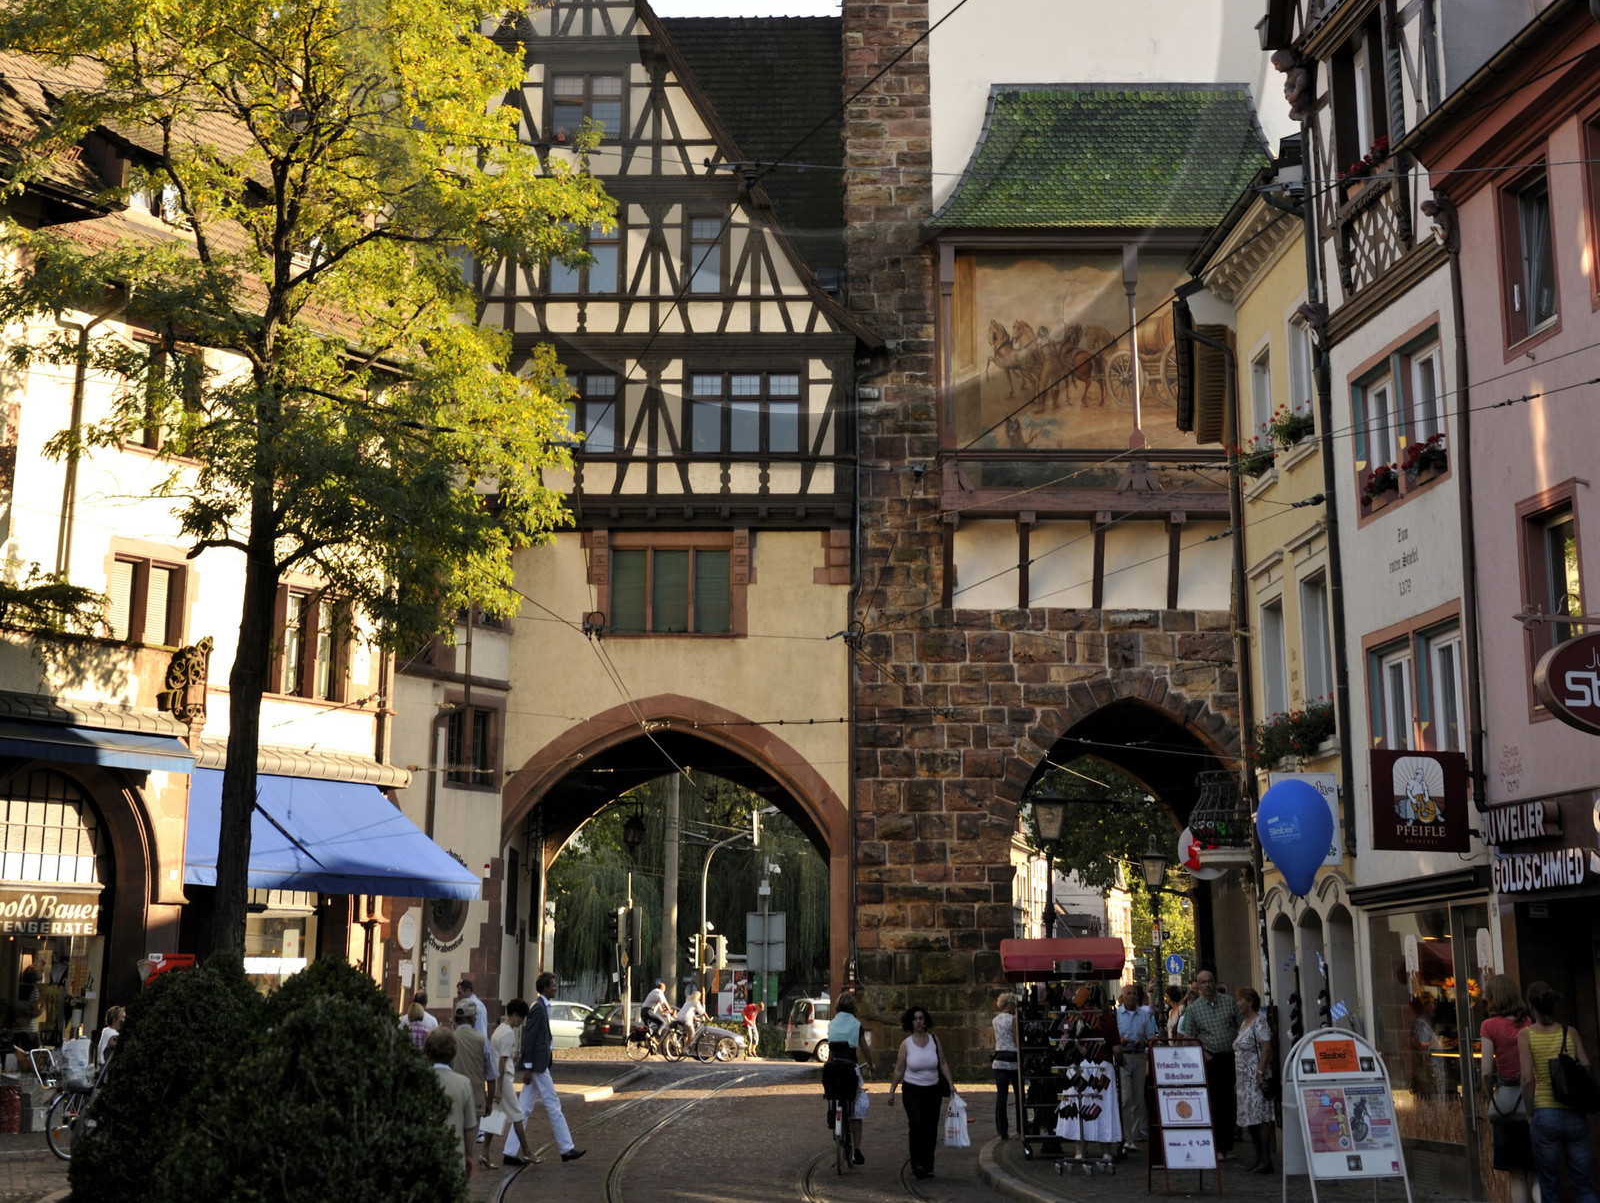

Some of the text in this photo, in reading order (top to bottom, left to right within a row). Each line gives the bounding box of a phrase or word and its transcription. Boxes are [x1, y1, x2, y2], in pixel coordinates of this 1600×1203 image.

[1396, 824, 1446, 837] PFEIFLE
[1481, 801, 1546, 846] JUWELIER
[1492, 847, 1585, 894] GOLDSCHMIED
